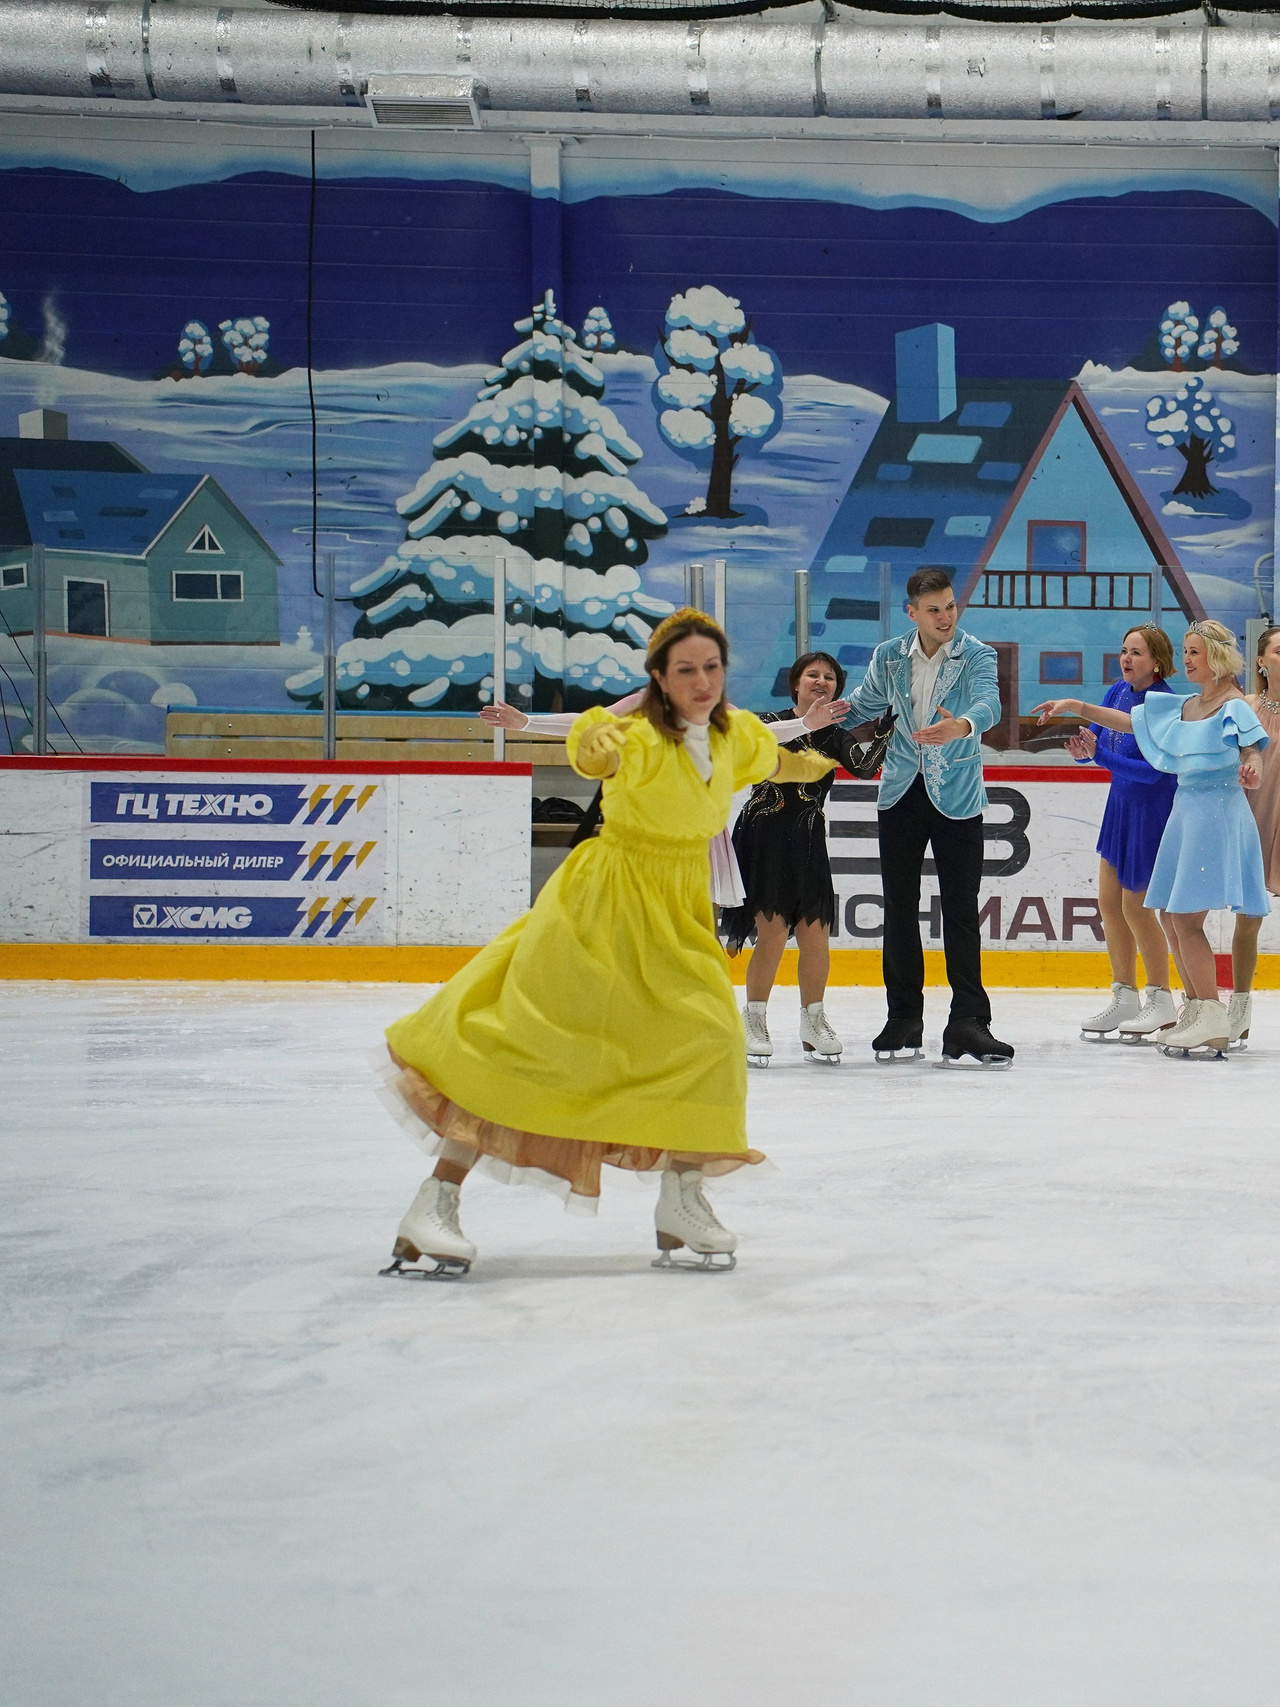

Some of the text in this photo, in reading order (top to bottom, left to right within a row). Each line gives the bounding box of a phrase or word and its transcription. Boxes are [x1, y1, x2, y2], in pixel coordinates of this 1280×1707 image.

[115, 793, 273, 819] ГЦ ТЕХНО
[102, 852, 284, 870] ОФИЦИАЛЬНЫЙ ДИЛЕР
[157, 905, 253, 929] XCMG
